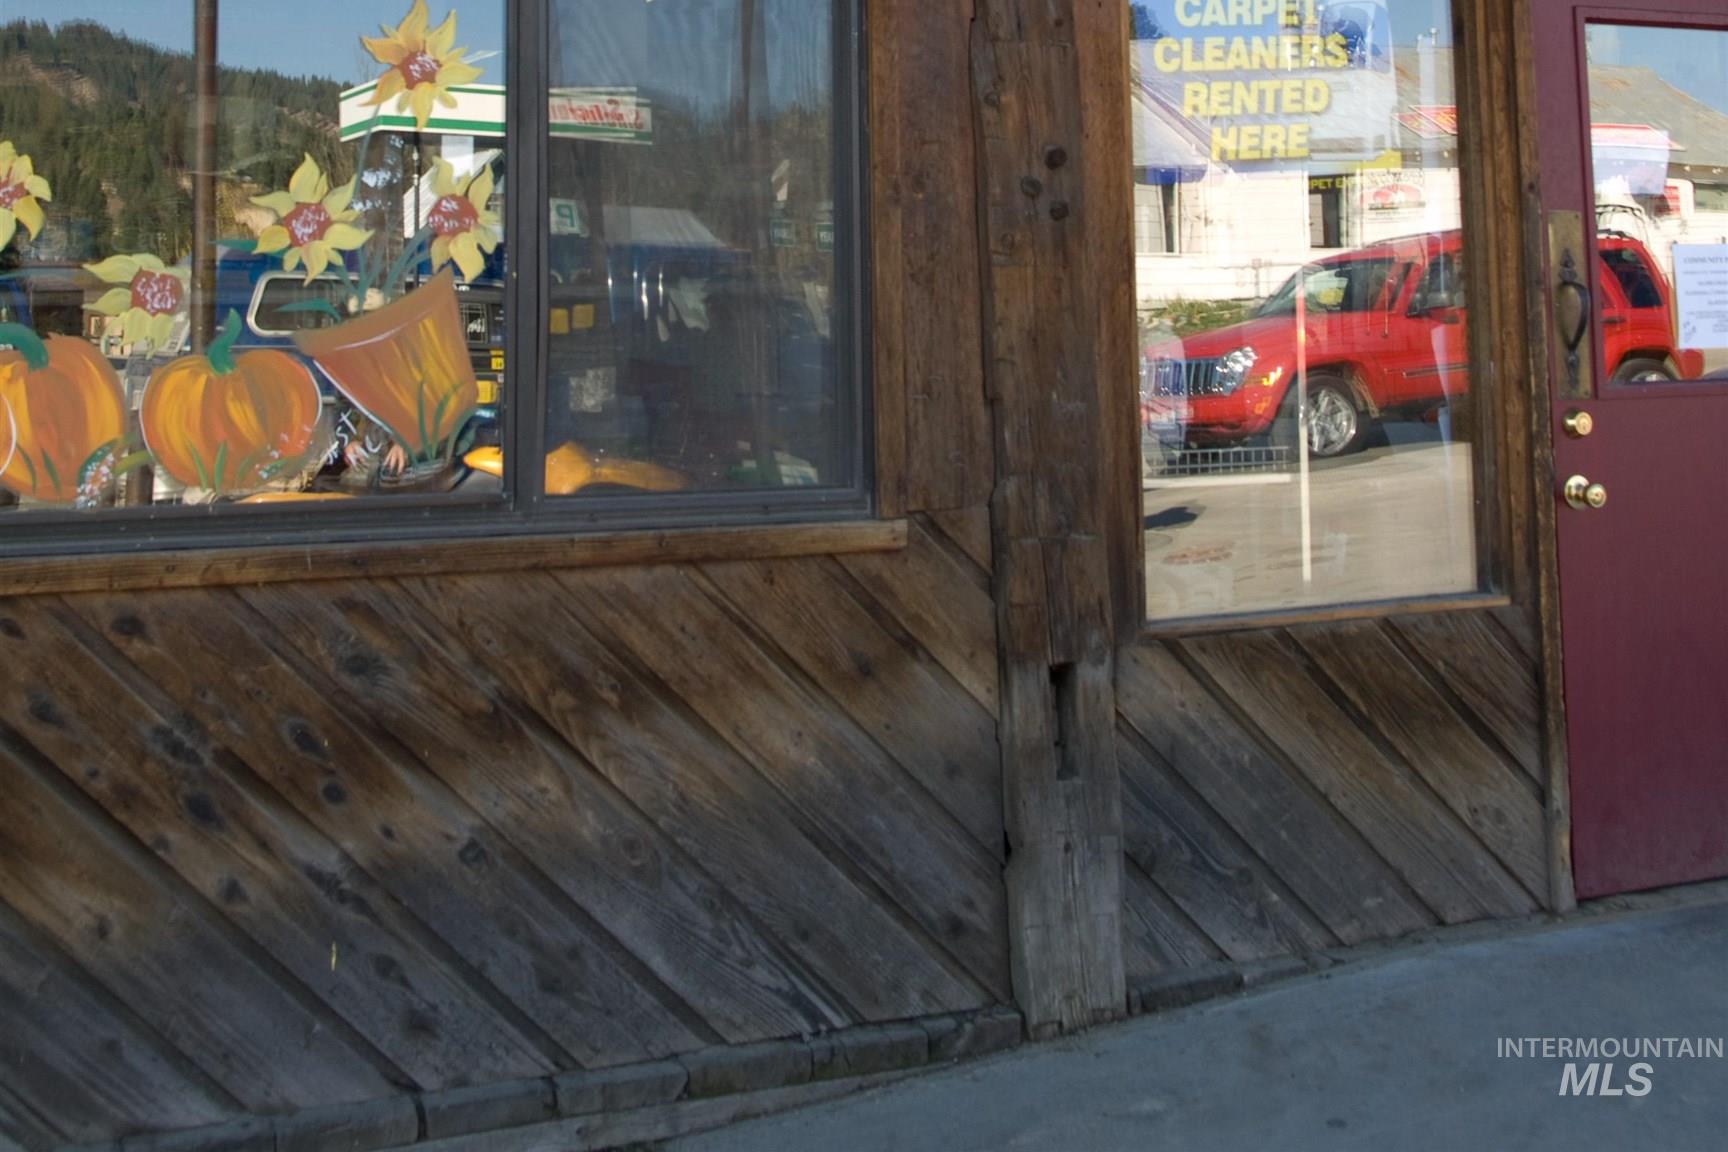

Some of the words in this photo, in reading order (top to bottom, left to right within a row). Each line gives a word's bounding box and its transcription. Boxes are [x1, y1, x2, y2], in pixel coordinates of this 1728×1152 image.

[1153, 34, 1349, 73] CLEANERS
[1182, 79, 1330, 118] RENTED
[1211, 123, 1310, 161] HERE
